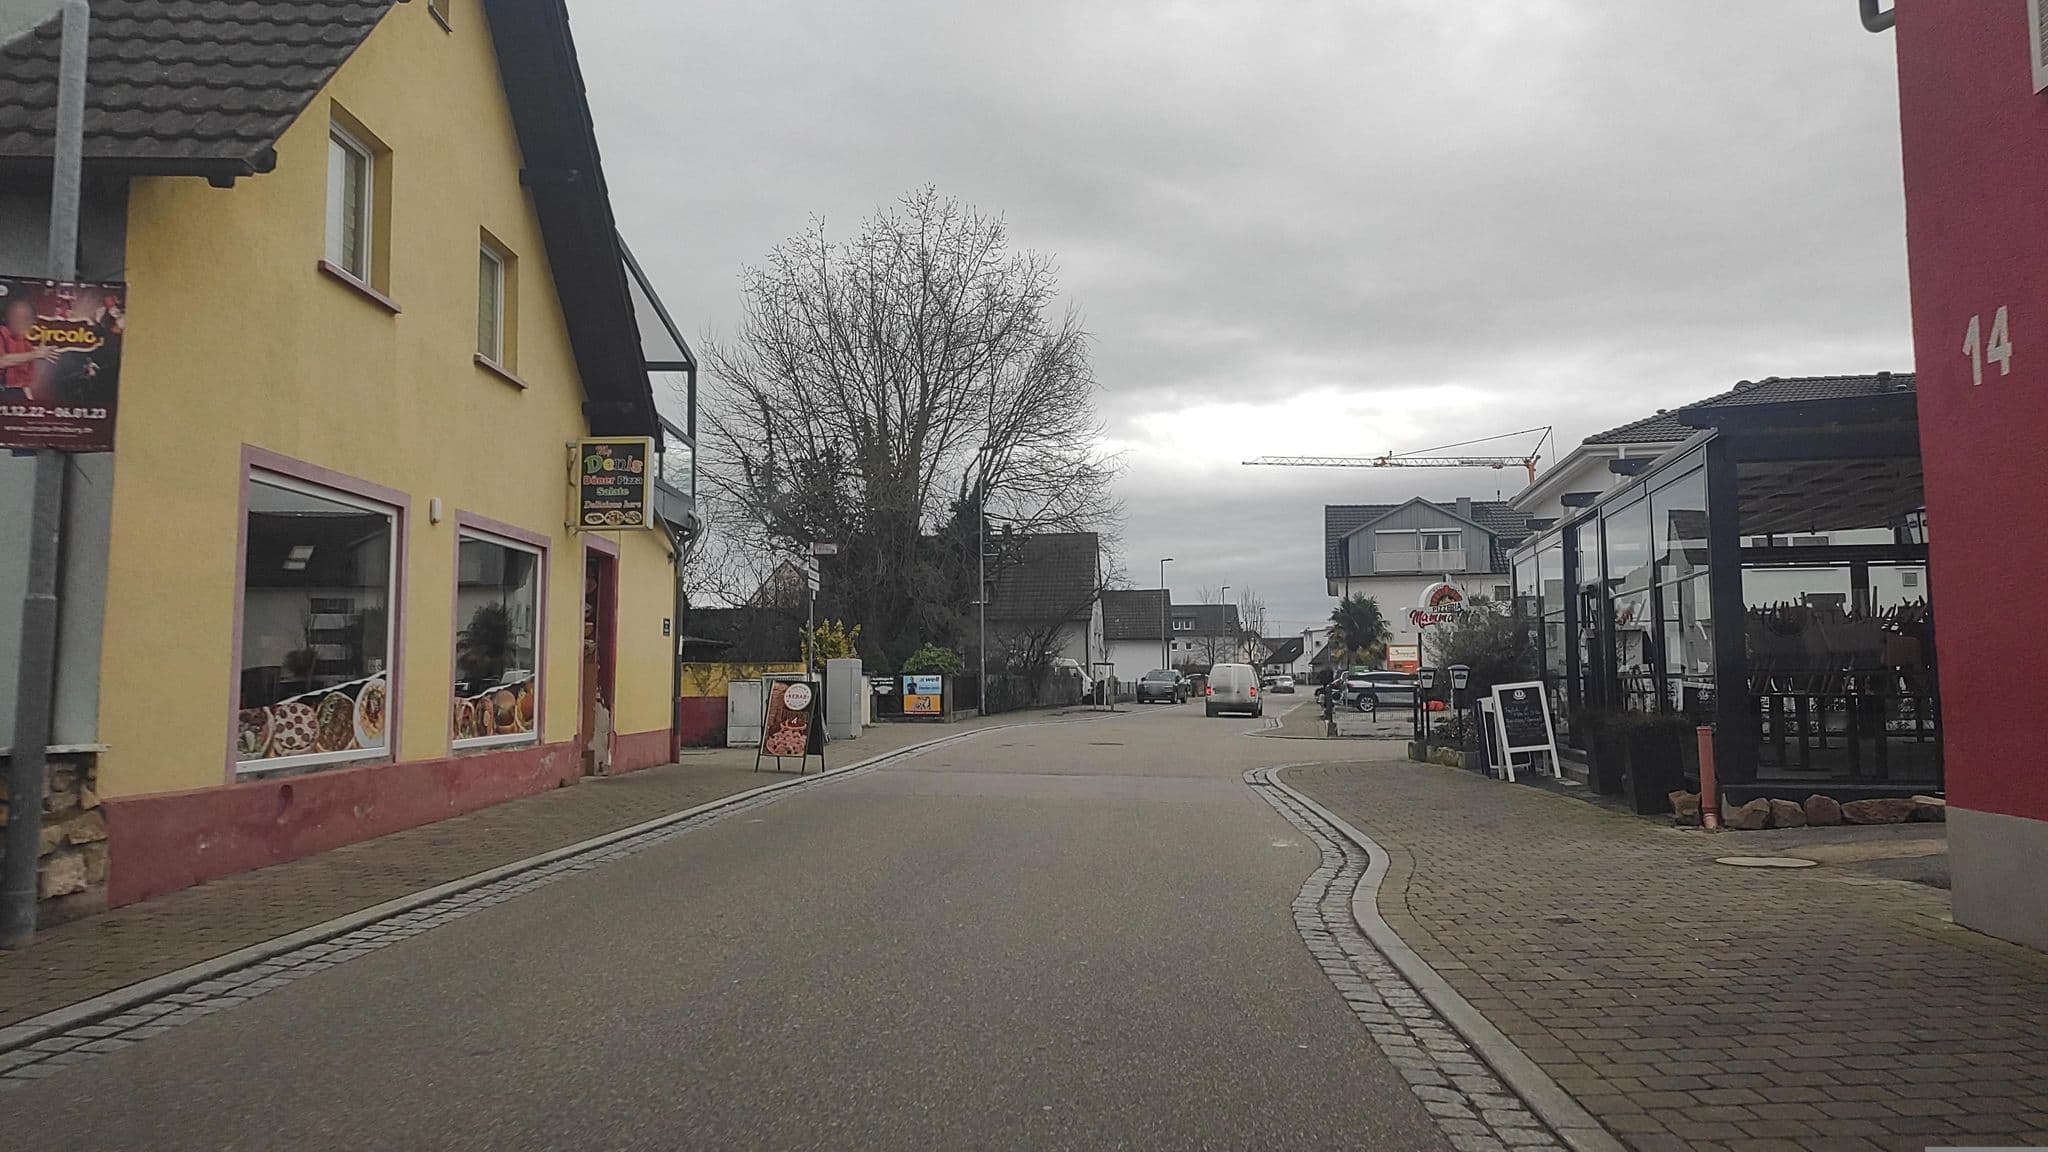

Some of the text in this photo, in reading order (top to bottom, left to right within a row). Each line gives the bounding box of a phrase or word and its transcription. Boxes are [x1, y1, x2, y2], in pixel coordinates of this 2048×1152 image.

[1962, 305, 2013, 386] 14
[0, 405, 45, 418] 1.12.22
[616, 475, 643, 485] Pizza
[1409, 610, 1454, 628] Mamma
